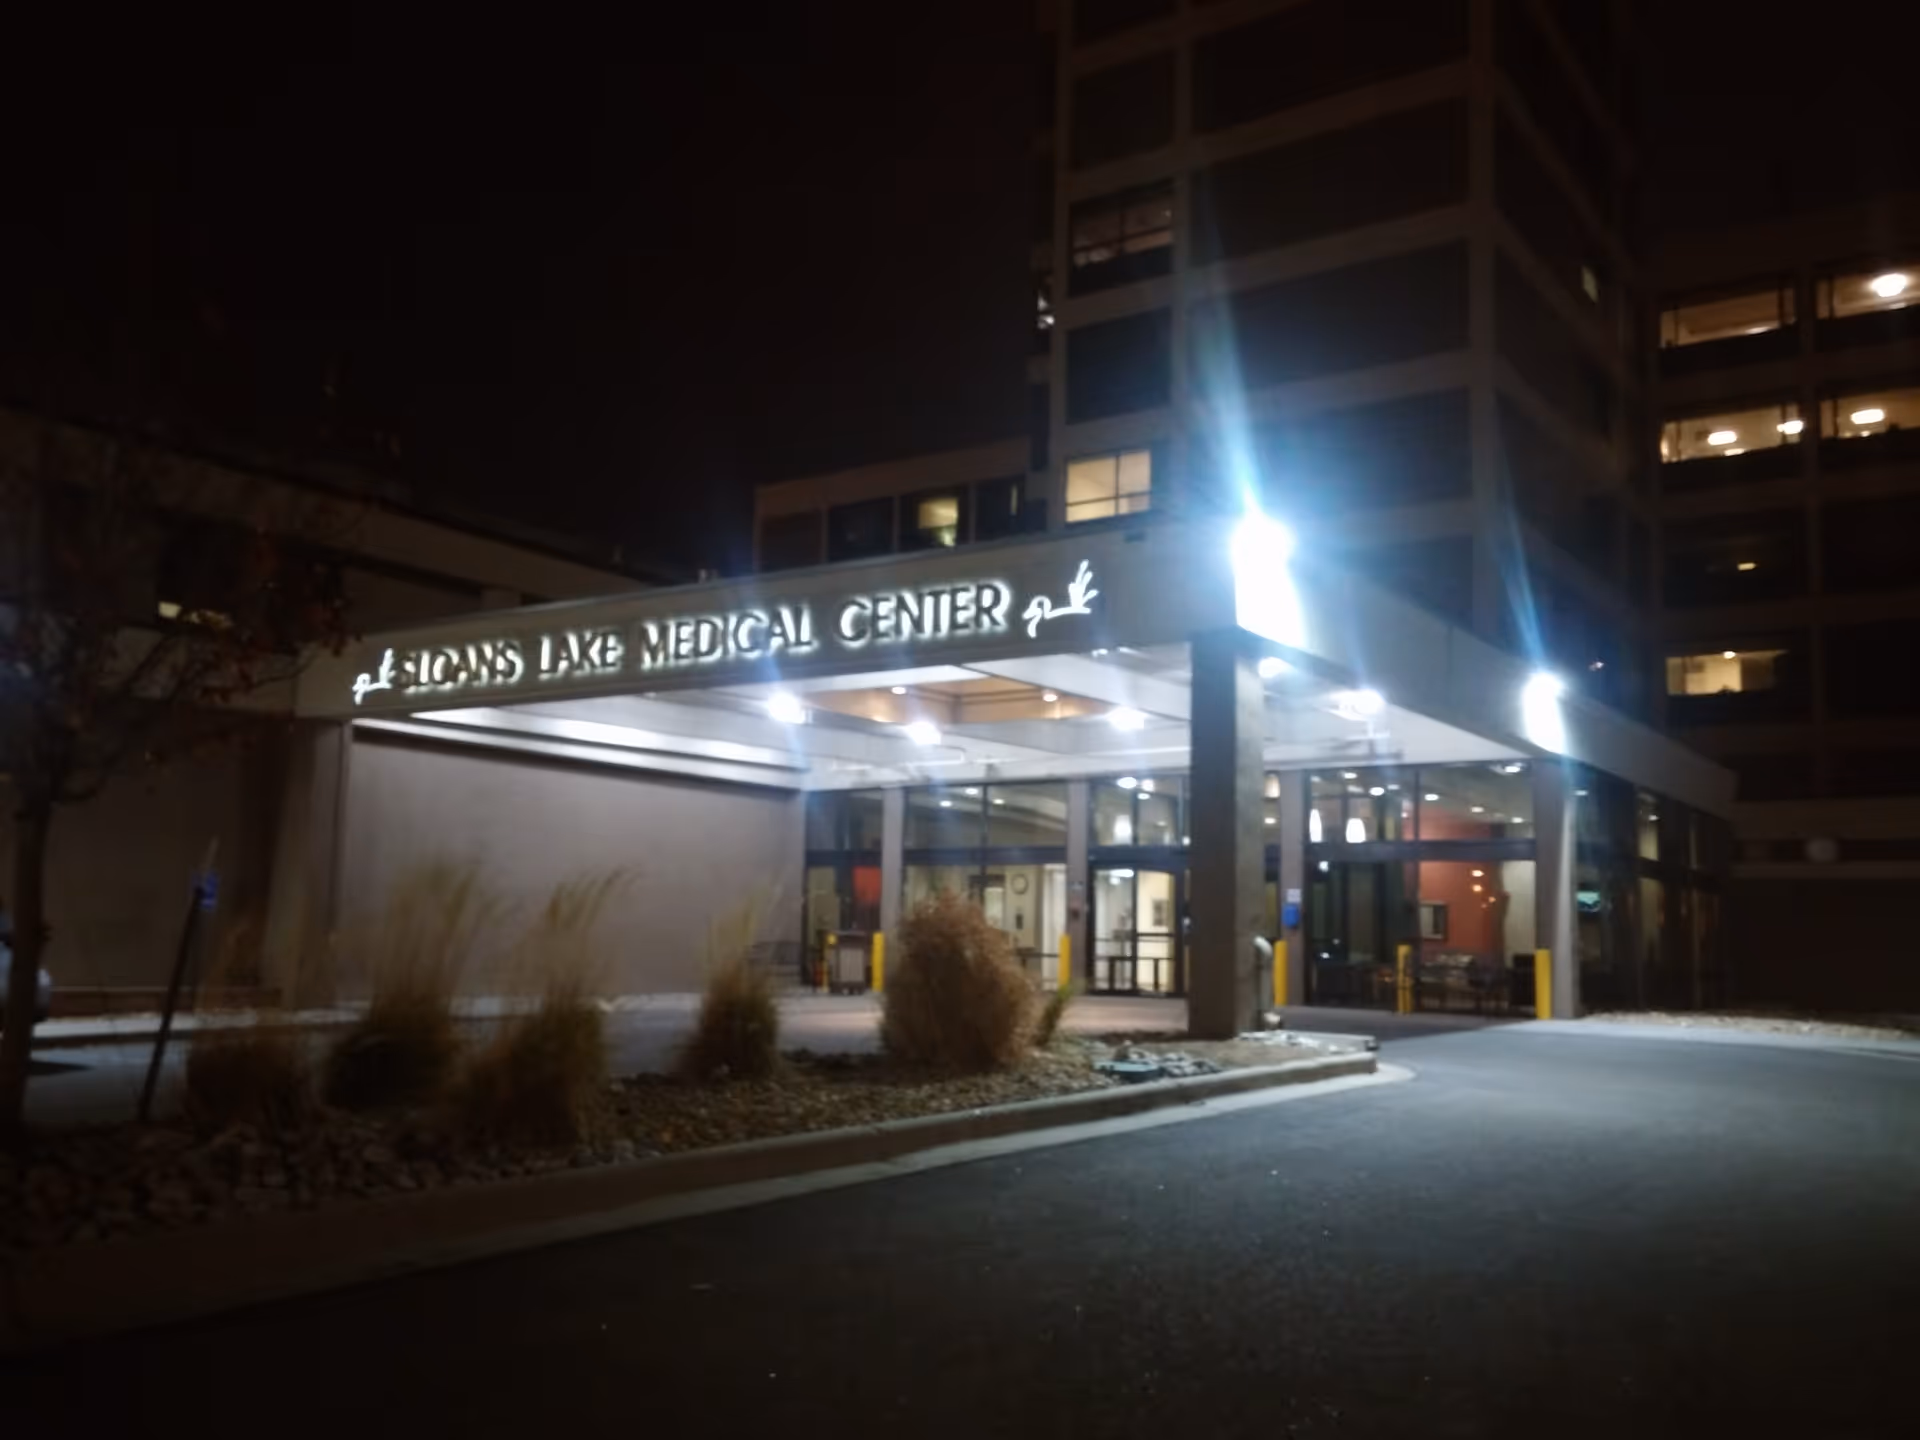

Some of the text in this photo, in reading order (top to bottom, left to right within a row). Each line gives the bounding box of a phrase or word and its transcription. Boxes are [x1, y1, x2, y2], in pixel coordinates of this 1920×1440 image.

[537, 629, 624, 679] LAKE
[638, 605, 816, 669] MEDICAL
[837, 579, 1011, 648] CENTER
